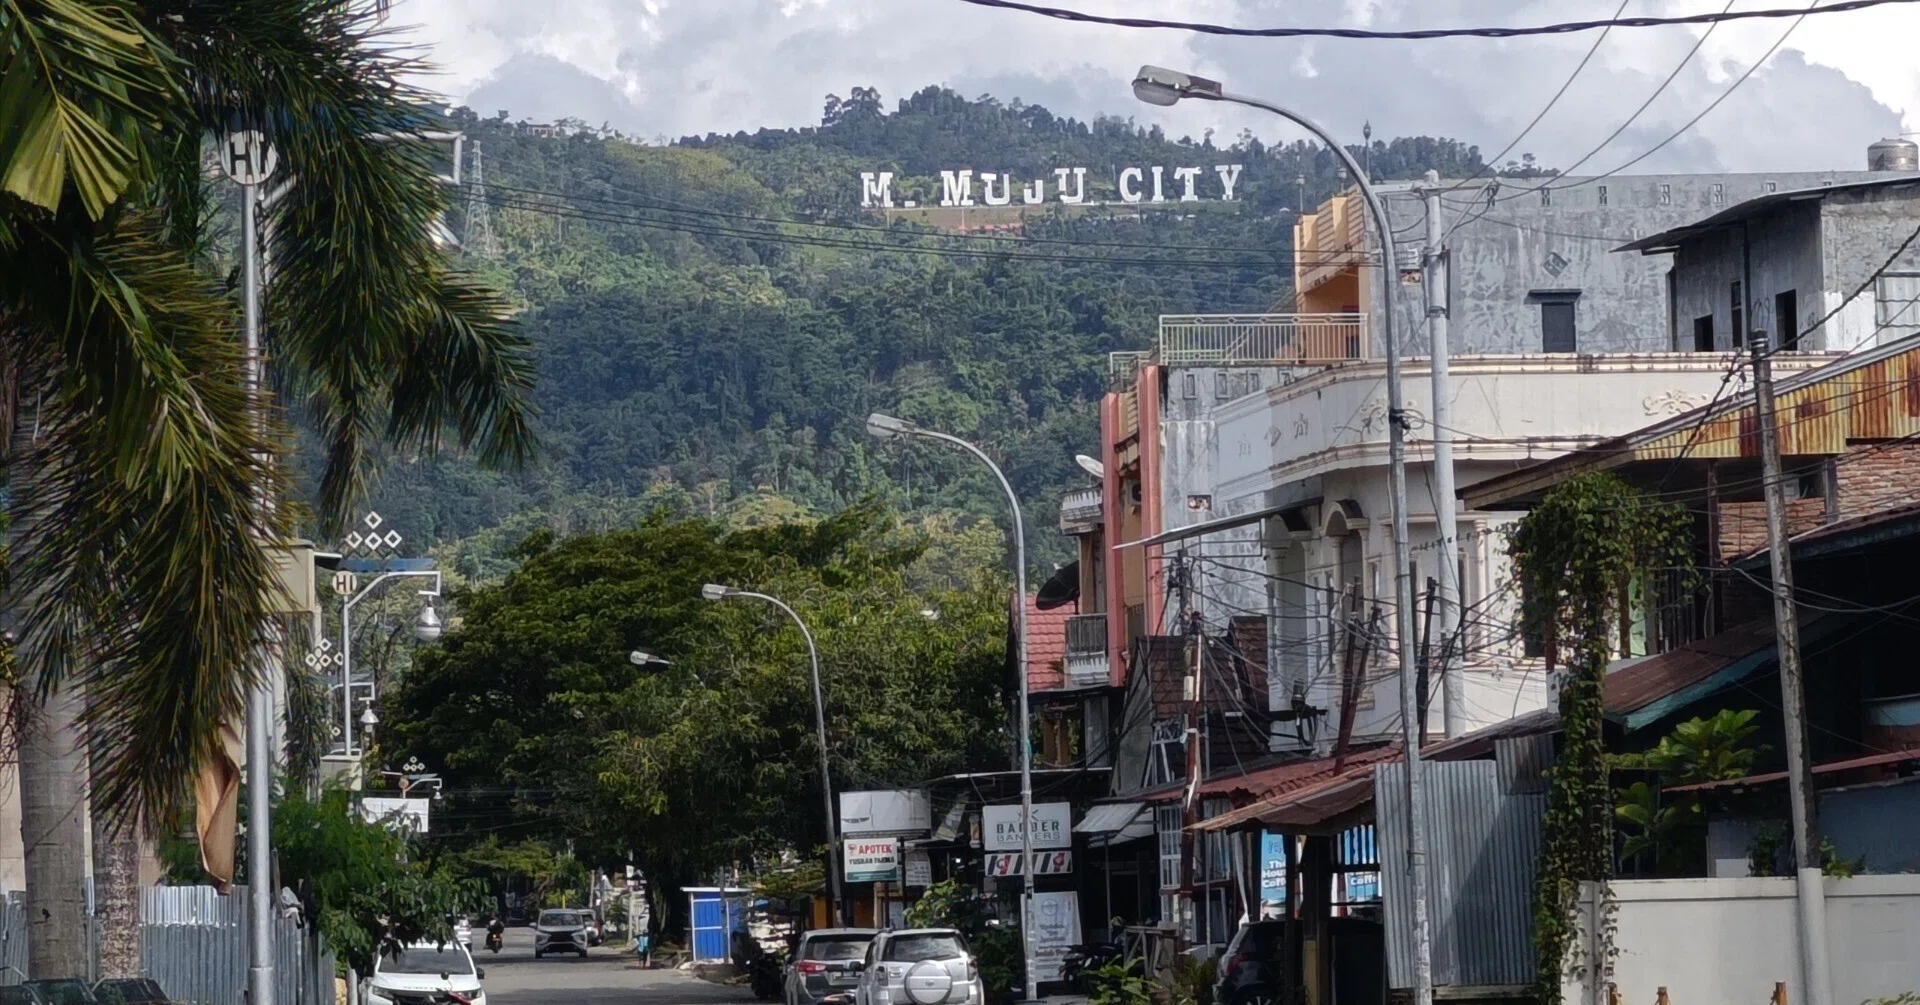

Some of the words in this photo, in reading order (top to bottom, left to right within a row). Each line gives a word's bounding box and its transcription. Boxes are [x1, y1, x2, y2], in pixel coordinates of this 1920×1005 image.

[1118, 164, 1243, 203] CITY
[996, 831, 1061, 841] BANERS
[859, 844, 892, 854] APOTEK
